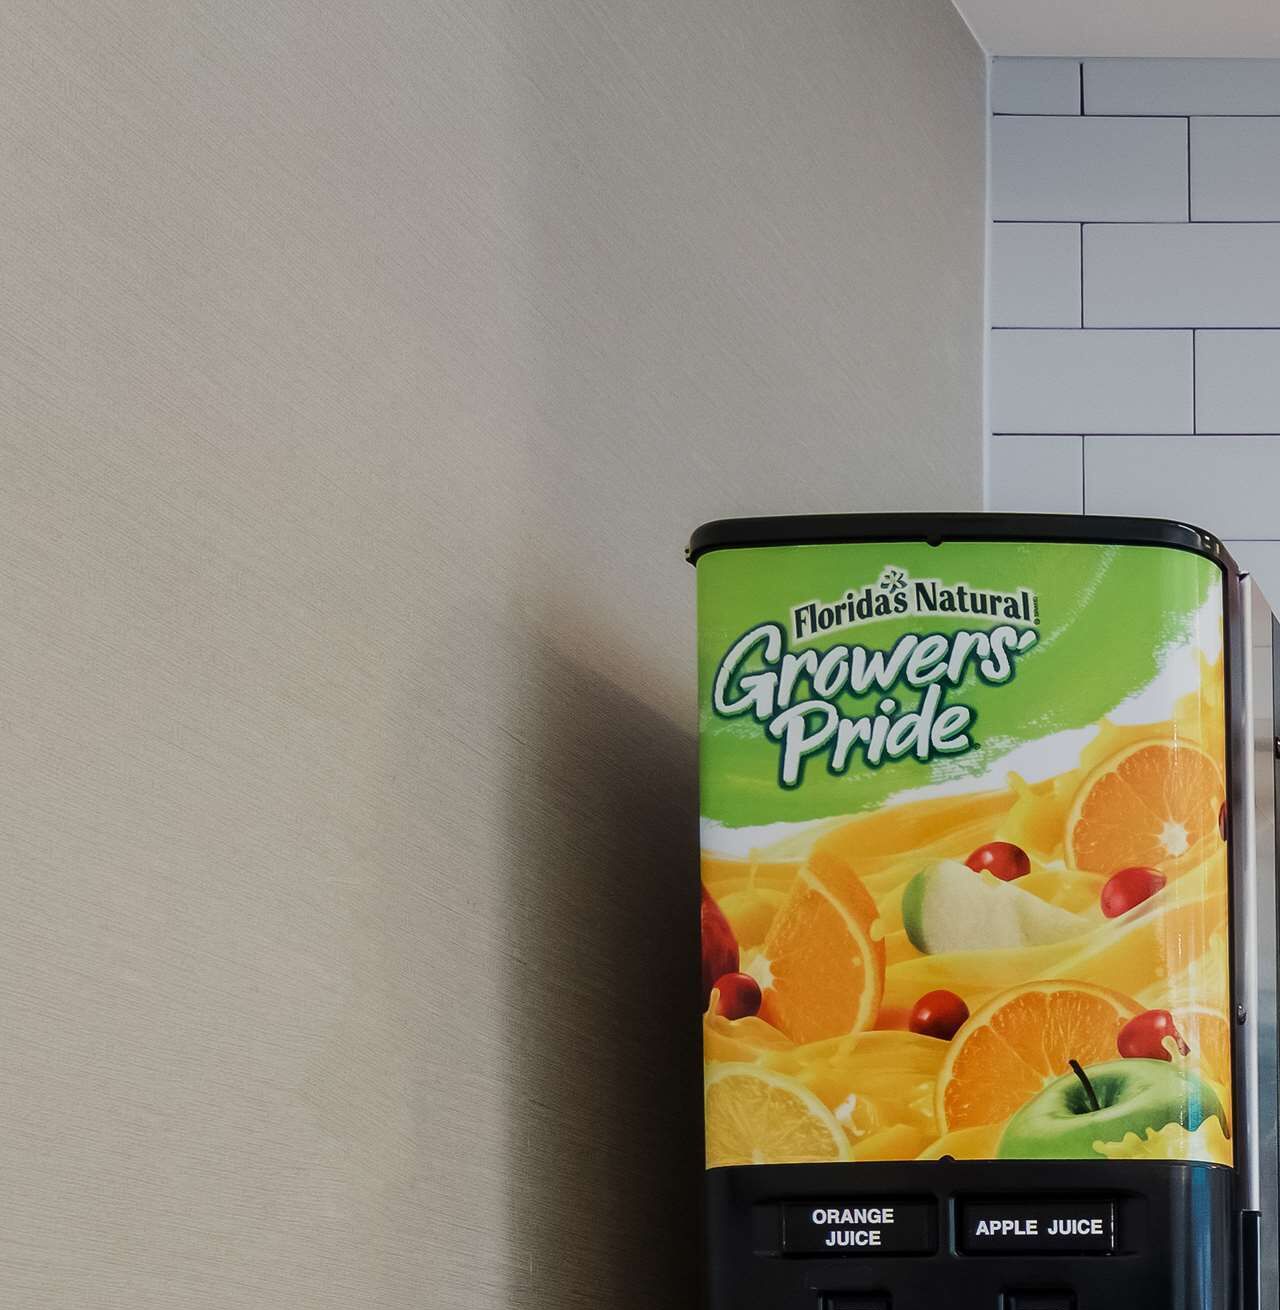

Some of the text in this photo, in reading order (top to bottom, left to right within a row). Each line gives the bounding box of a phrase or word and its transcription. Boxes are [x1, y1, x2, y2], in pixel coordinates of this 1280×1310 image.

[915, 582, 1031, 621] Natural
[773, 685, 970, 784] Pride
[812, 1208, 895, 1225] ORANGE
[975, 1219, 1104, 1236] APPLE JUICE
[825, 1230, 882, 1247] JUICE
